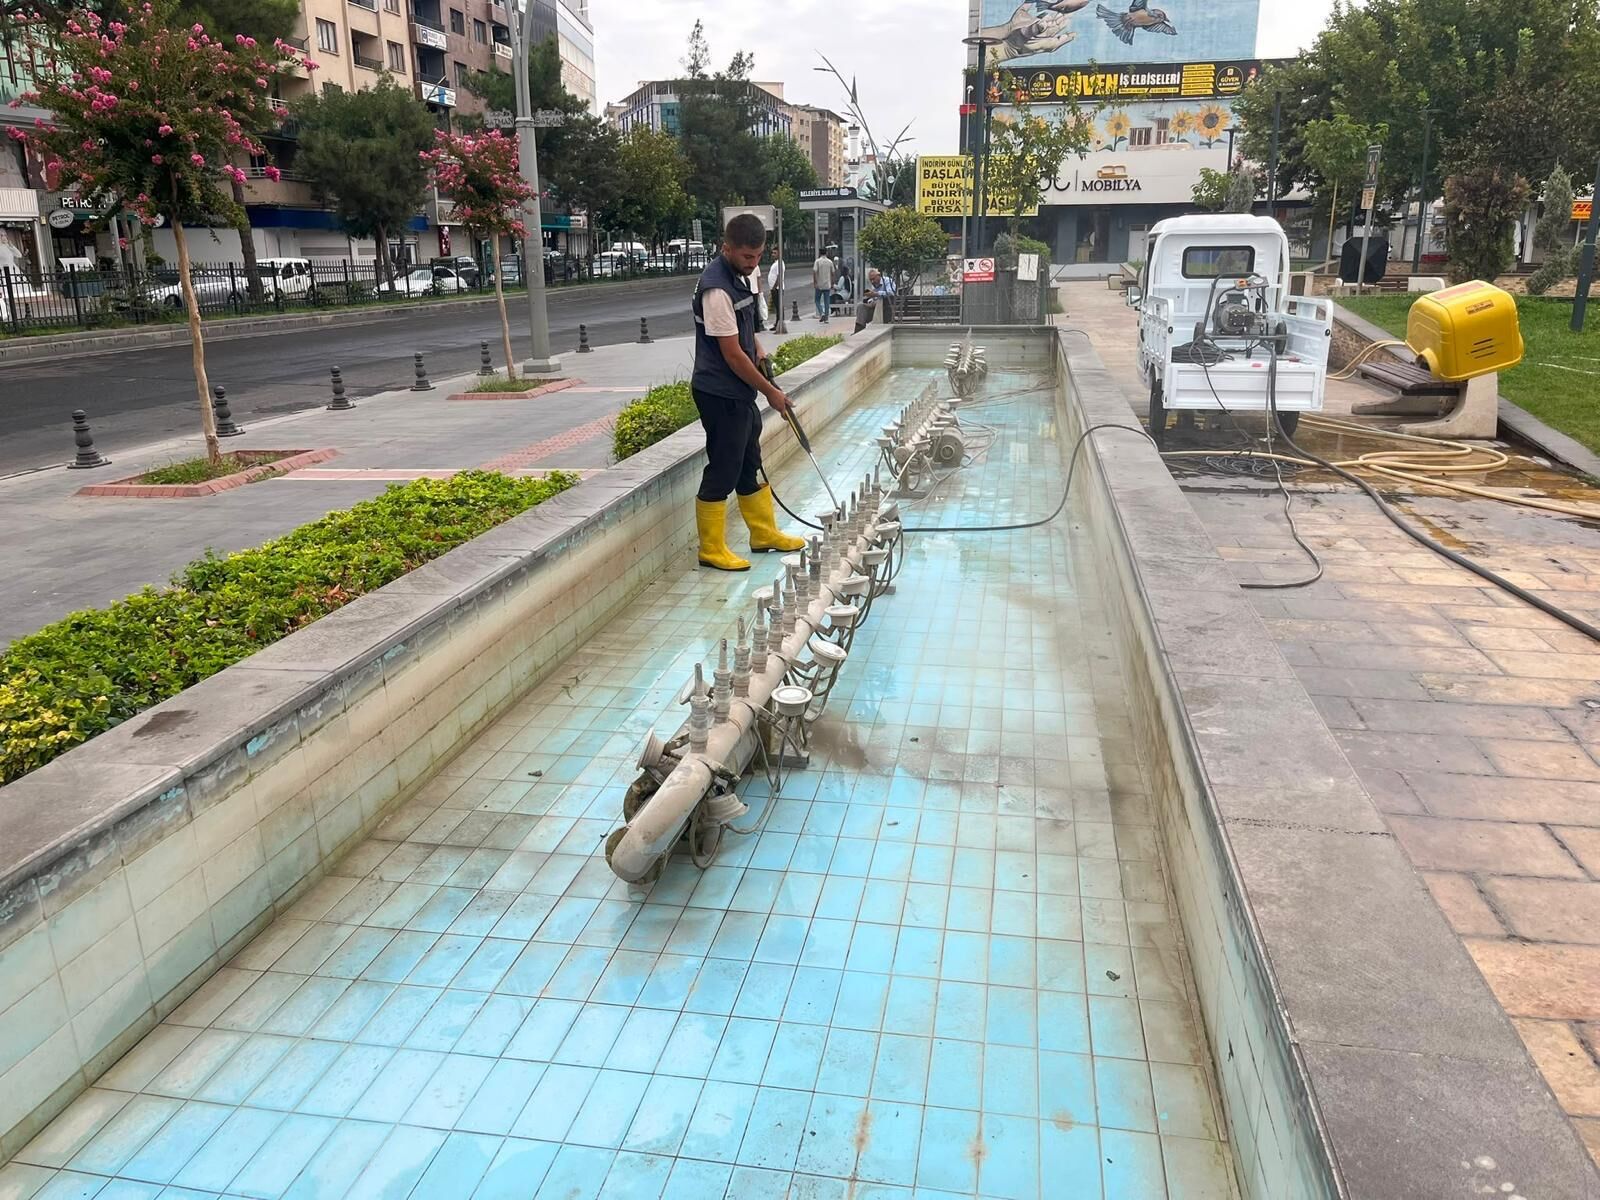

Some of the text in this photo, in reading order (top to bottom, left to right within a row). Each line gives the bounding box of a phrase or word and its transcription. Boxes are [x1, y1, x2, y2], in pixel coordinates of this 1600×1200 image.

[1056, 71, 1119, 97] GÜVEN
[1120, 73, 1129, 87] İŞ
[1131, 72, 1180, 86] ELBİSELERİ
